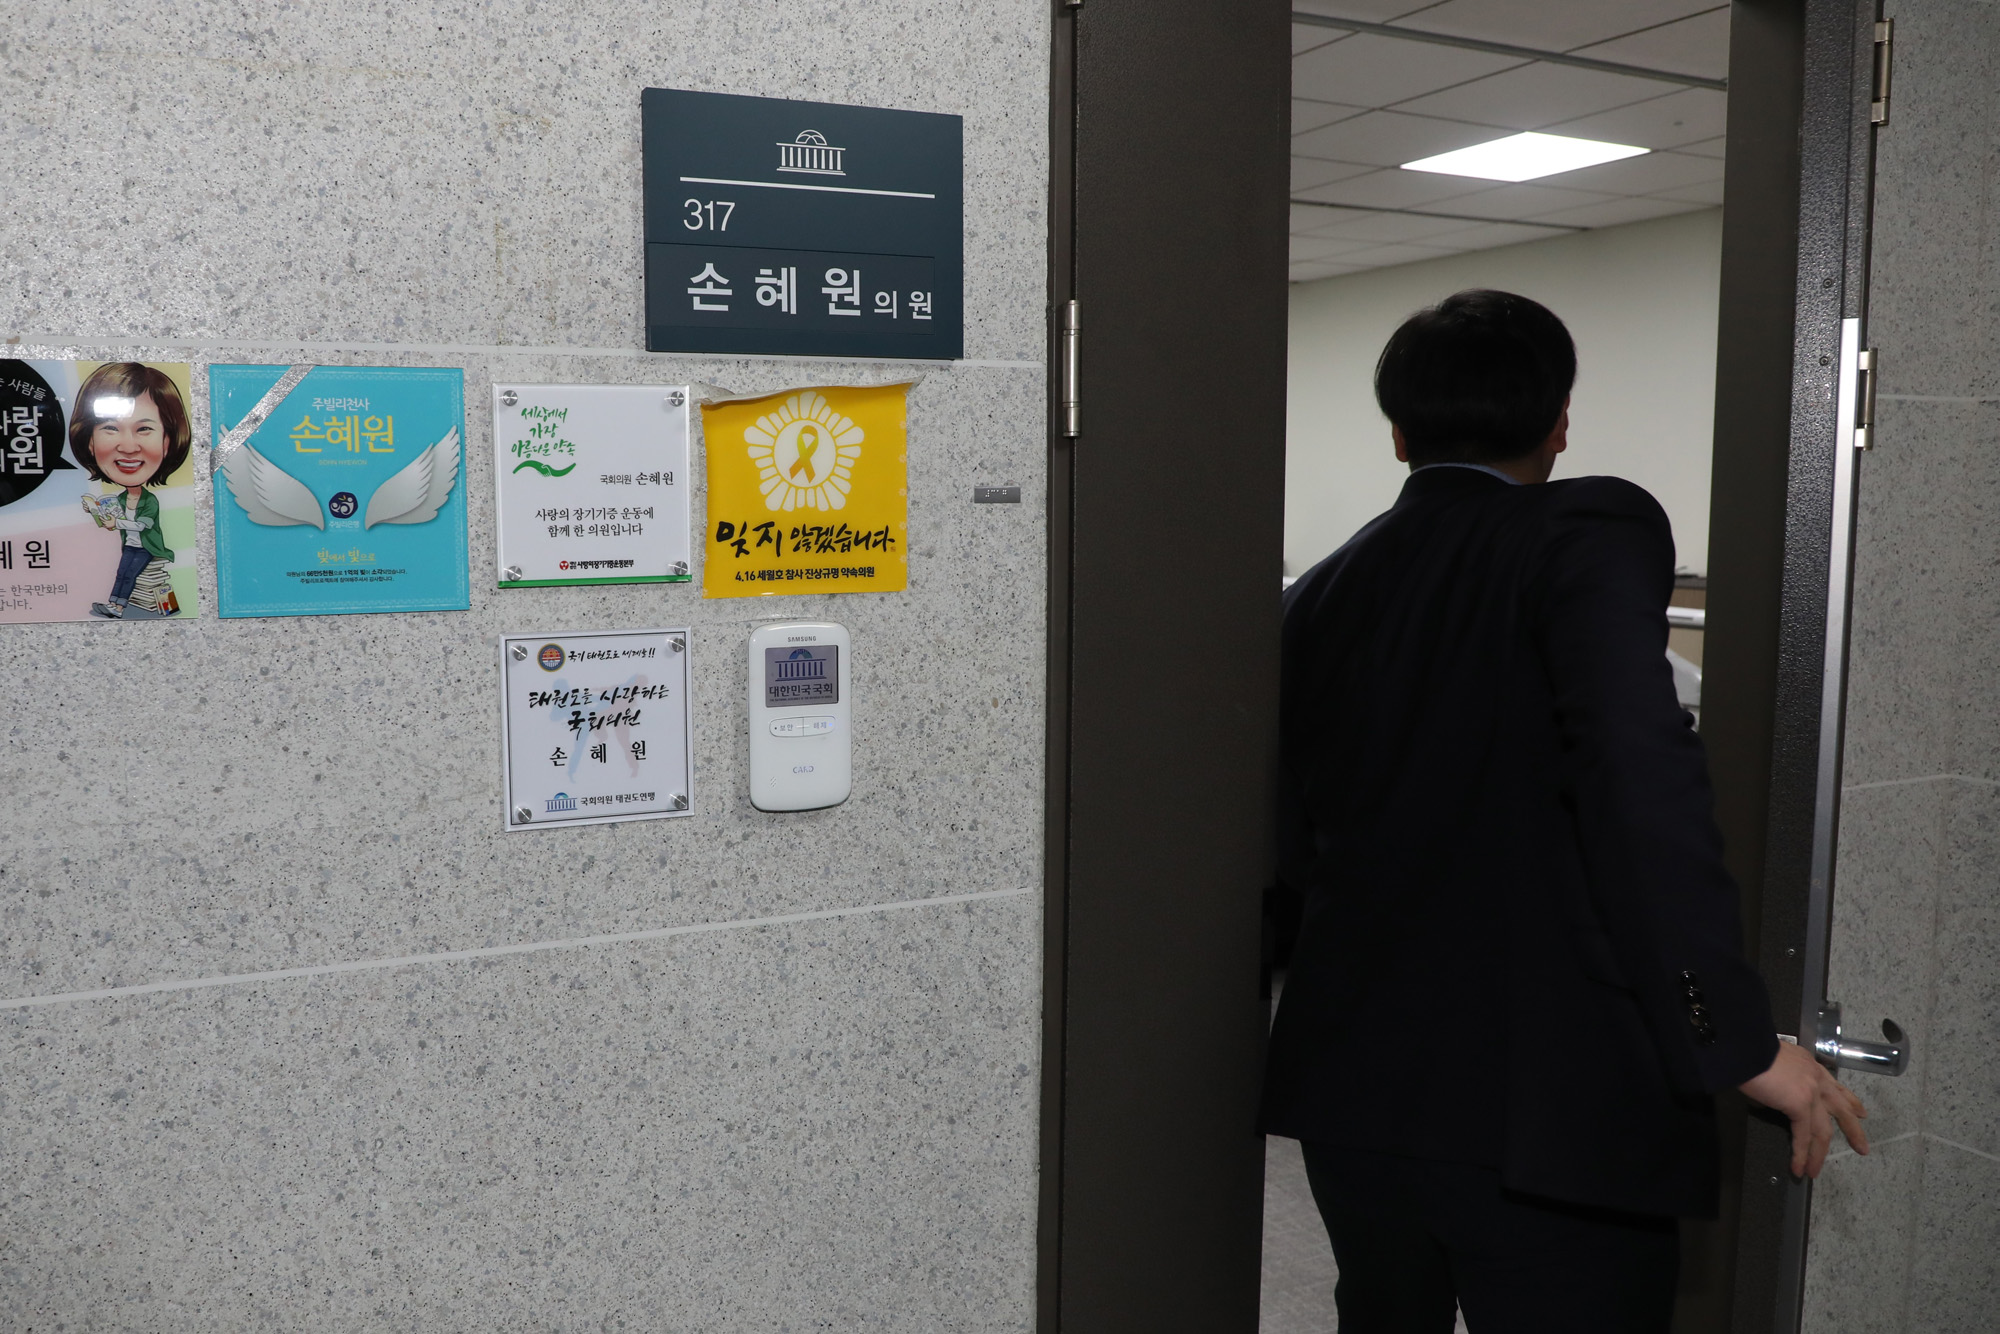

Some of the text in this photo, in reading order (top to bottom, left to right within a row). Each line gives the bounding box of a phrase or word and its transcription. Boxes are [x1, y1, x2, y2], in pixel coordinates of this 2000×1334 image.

[683, 198, 736, 232] 317
[8, 378, 46, 401] 사람들
[312, 397, 370, 411] 주빌리천사
[520, 406, 568, 424] 세상에서
[289, 414, 395, 453] 손혜원
[529, 422, 559, 440] 가장
[0, 436, 44, 474] 원
[511, 439, 577, 459] 아름다운 약속
[599, 471, 674, 486] 국회의원 손혜원
[535, 506, 654, 522] 사랑의 장기기증 운동에
[547, 523, 643, 538] 함께 한 의원입니다
[716, 520, 783, 558] 잊지
[577, 559, 634, 570] 사랑의장기기증운동본부
[735, 566, 875, 582] 4.16 세월호 참사 진상규명 약속의원
[10, 583, 68, 597] 한국만화의
[568, 650, 586, 662] 국기
[529, 684, 670, 709] 태권도를 사랑하는
[567, 708, 641, 741] 국회의원
[779, 723, 794, 732] 보안
[792, 765, 815, 774] CARD
[580, 791, 656, 807] 국회의원 태권도연맹
